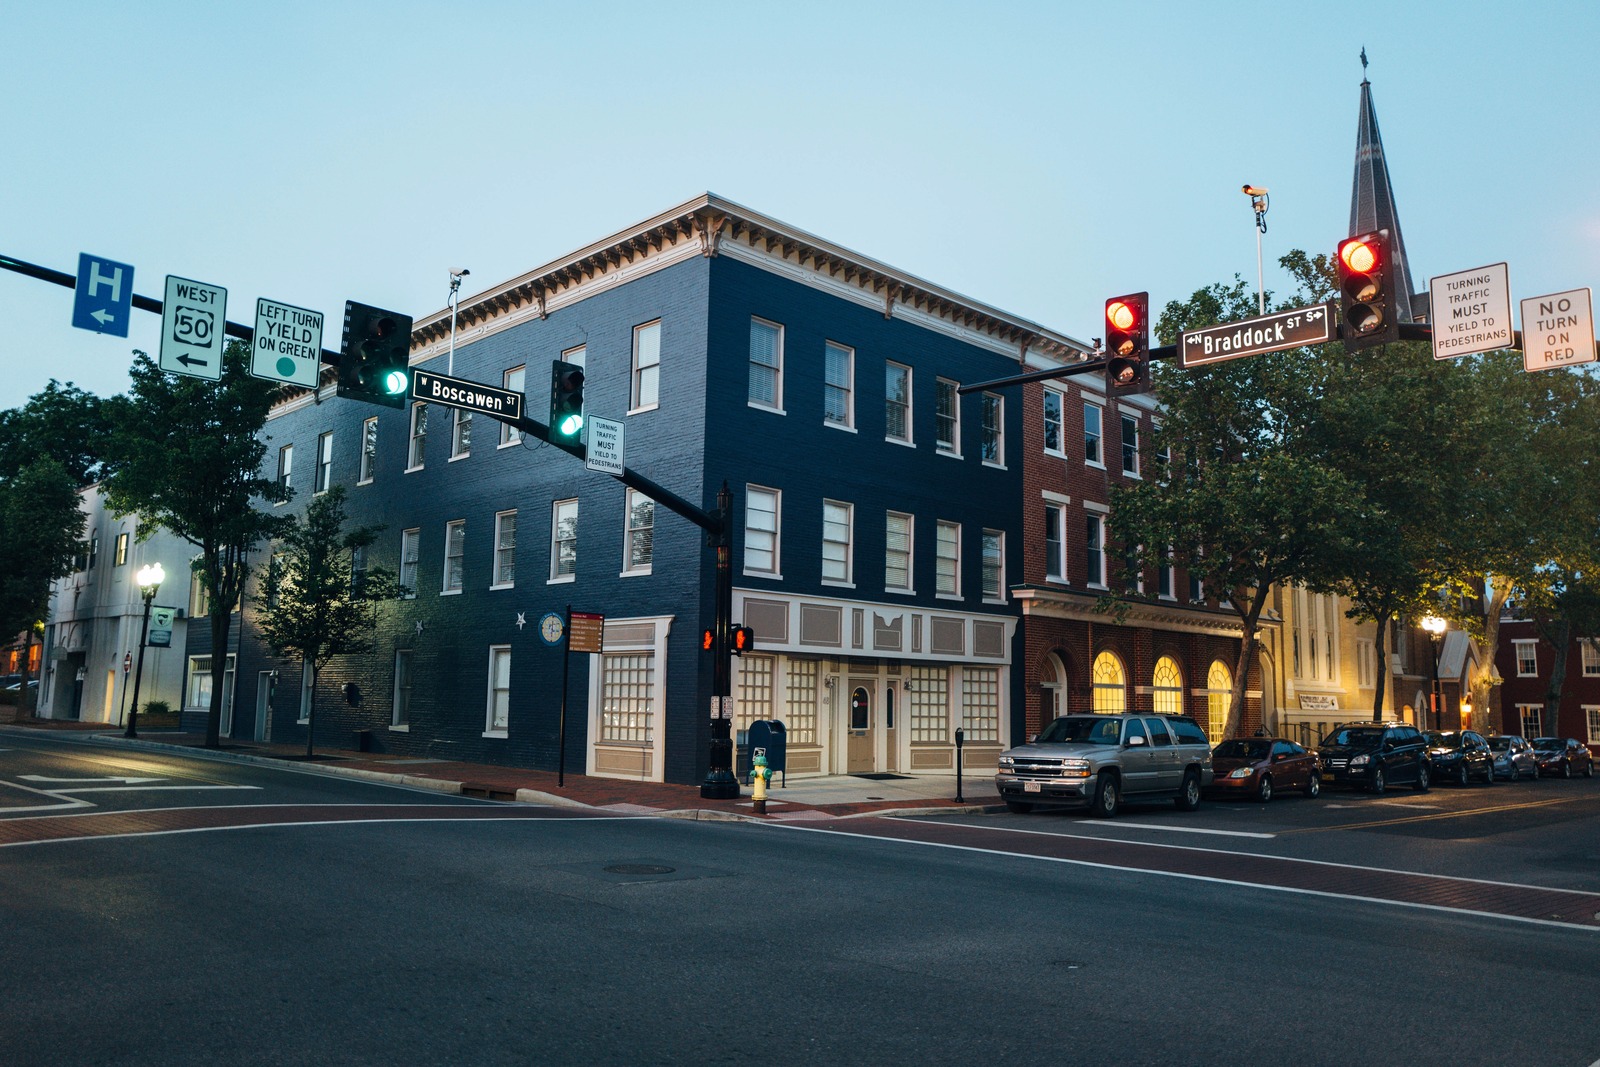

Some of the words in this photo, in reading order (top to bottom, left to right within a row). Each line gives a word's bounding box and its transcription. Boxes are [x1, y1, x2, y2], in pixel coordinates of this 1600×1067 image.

[88, 261, 123, 302] H
[1446, 275, 1491, 291] TURNING
[176, 283, 217, 305] WEST
[1448, 288, 1490, 304] TRAFFIC
[1452, 303, 1488, 320] MUST
[1539, 298, 1571, 316] NO
[259, 303, 289, 319] LEFT
[291, 309, 320, 330] TURN
[1536, 315, 1577, 332] TURN
[179, 315, 209, 339] 50
[266, 320, 312, 344] YIELD
[1194, 334, 1202, 345] N
[1204, 322, 1285, 354] Braddock
[1286, 316, 1301, 329] ST
[1306, 311, 1314, 322] S
[1448, 321, 1478, 334] YIELD
[1482, 317, 1495, 326] TO
[1438, 329, 1507, 349] PEDESTRIANS
[1546, 332, 1569, 346] ON
[259, 336, 276, 350] ON
[279, 343, 316, 360] GREEN
[1544, 347, 1574, 362] RED
[421, 376, 427, 386] W
[432, 380, 502, 410] Boscawen
[506, 396, 515, 406] ST
[595, 421, 618, 433] TURNING
[596, 430, 617, 441] TRAFFIC
[597, 441, 615, 451] MUST
[588, 457, 622, 470] PEDESTRIANS
[594, 450, 608, 460] YIELD
